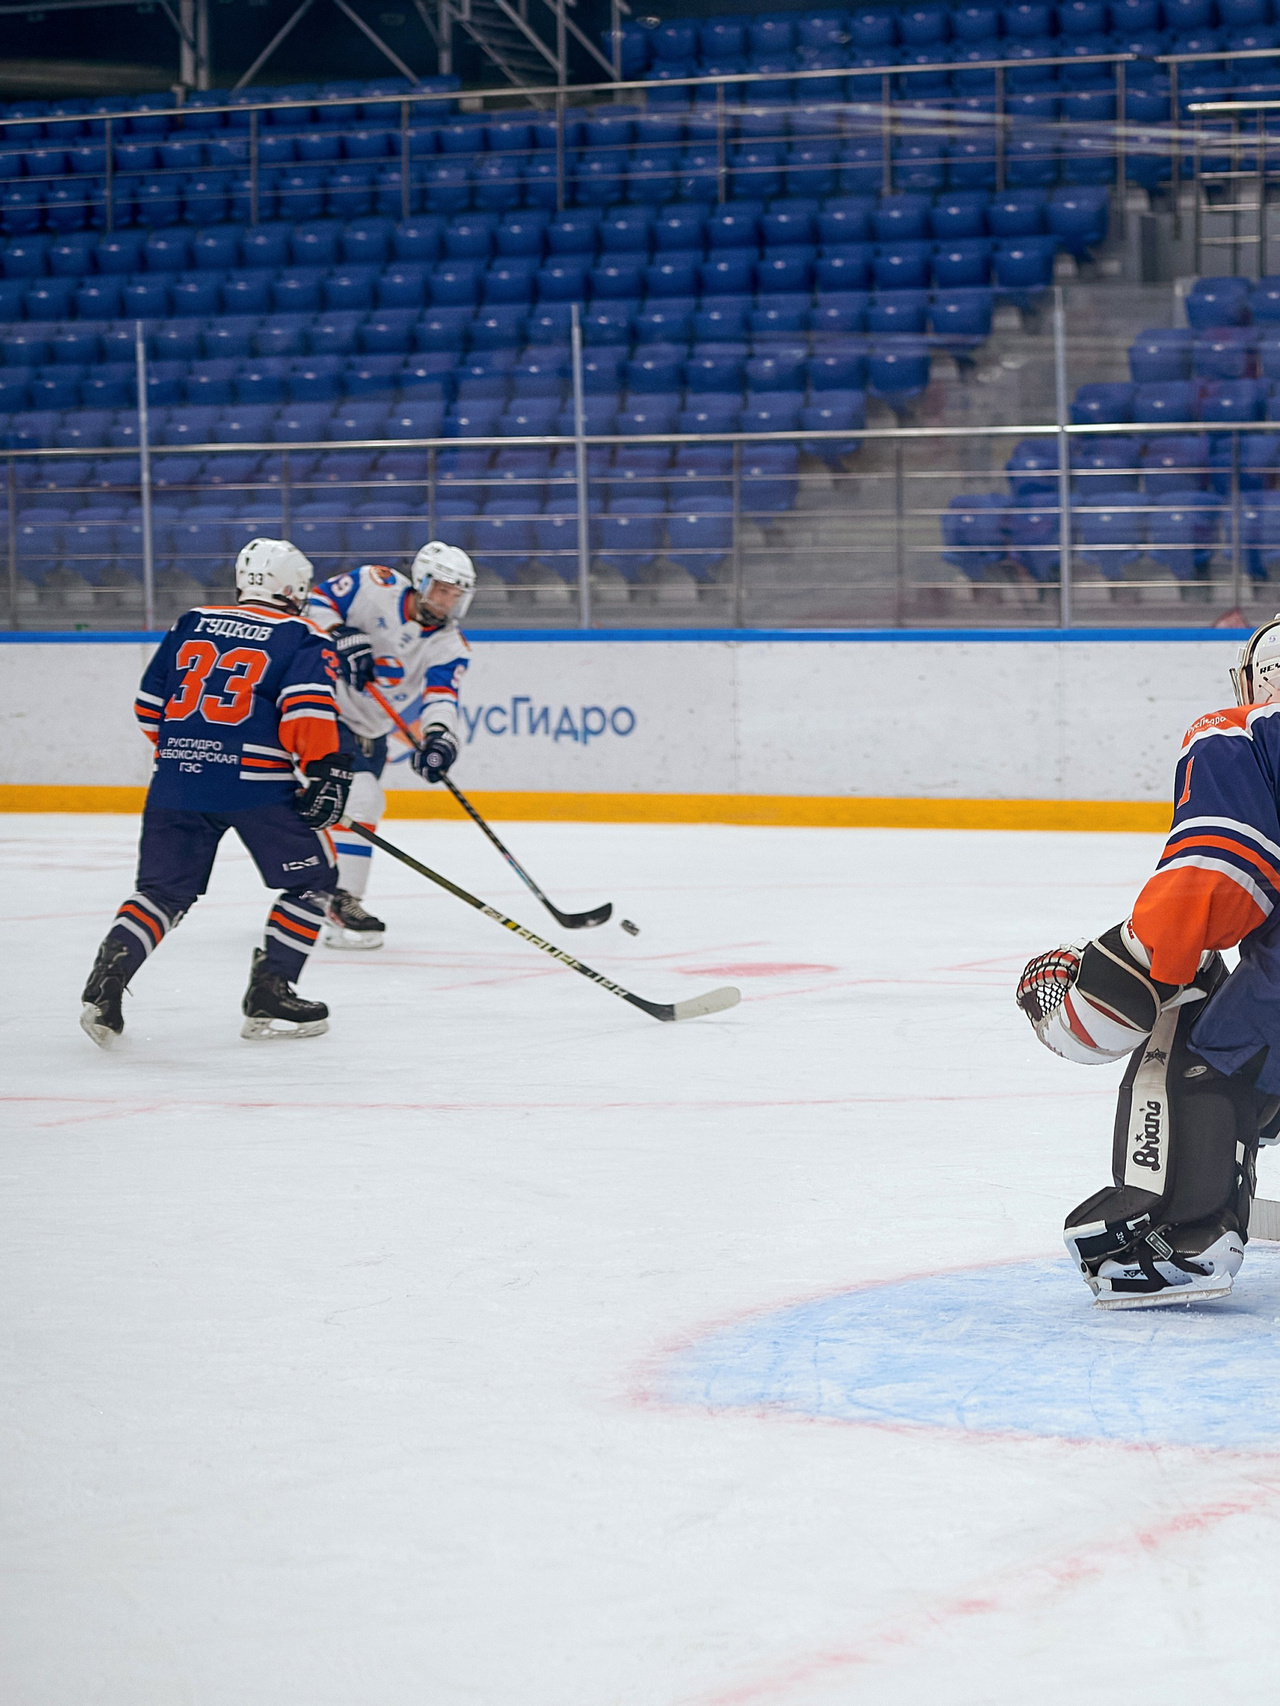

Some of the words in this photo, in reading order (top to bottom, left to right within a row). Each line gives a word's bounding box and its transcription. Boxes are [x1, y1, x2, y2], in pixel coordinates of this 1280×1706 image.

[248, 572, 264, 586] 33
[193, 617, 274, 641] ГУДКОВ
[164, 639, 271, 726] 33
[462, 695, 636, 745] усГидро
[167, 737, 223, 751] РУСГИДРО
[179, 762, 202, 773] ГЭС
[1132, 1100, 1161, 1171] Brian's
